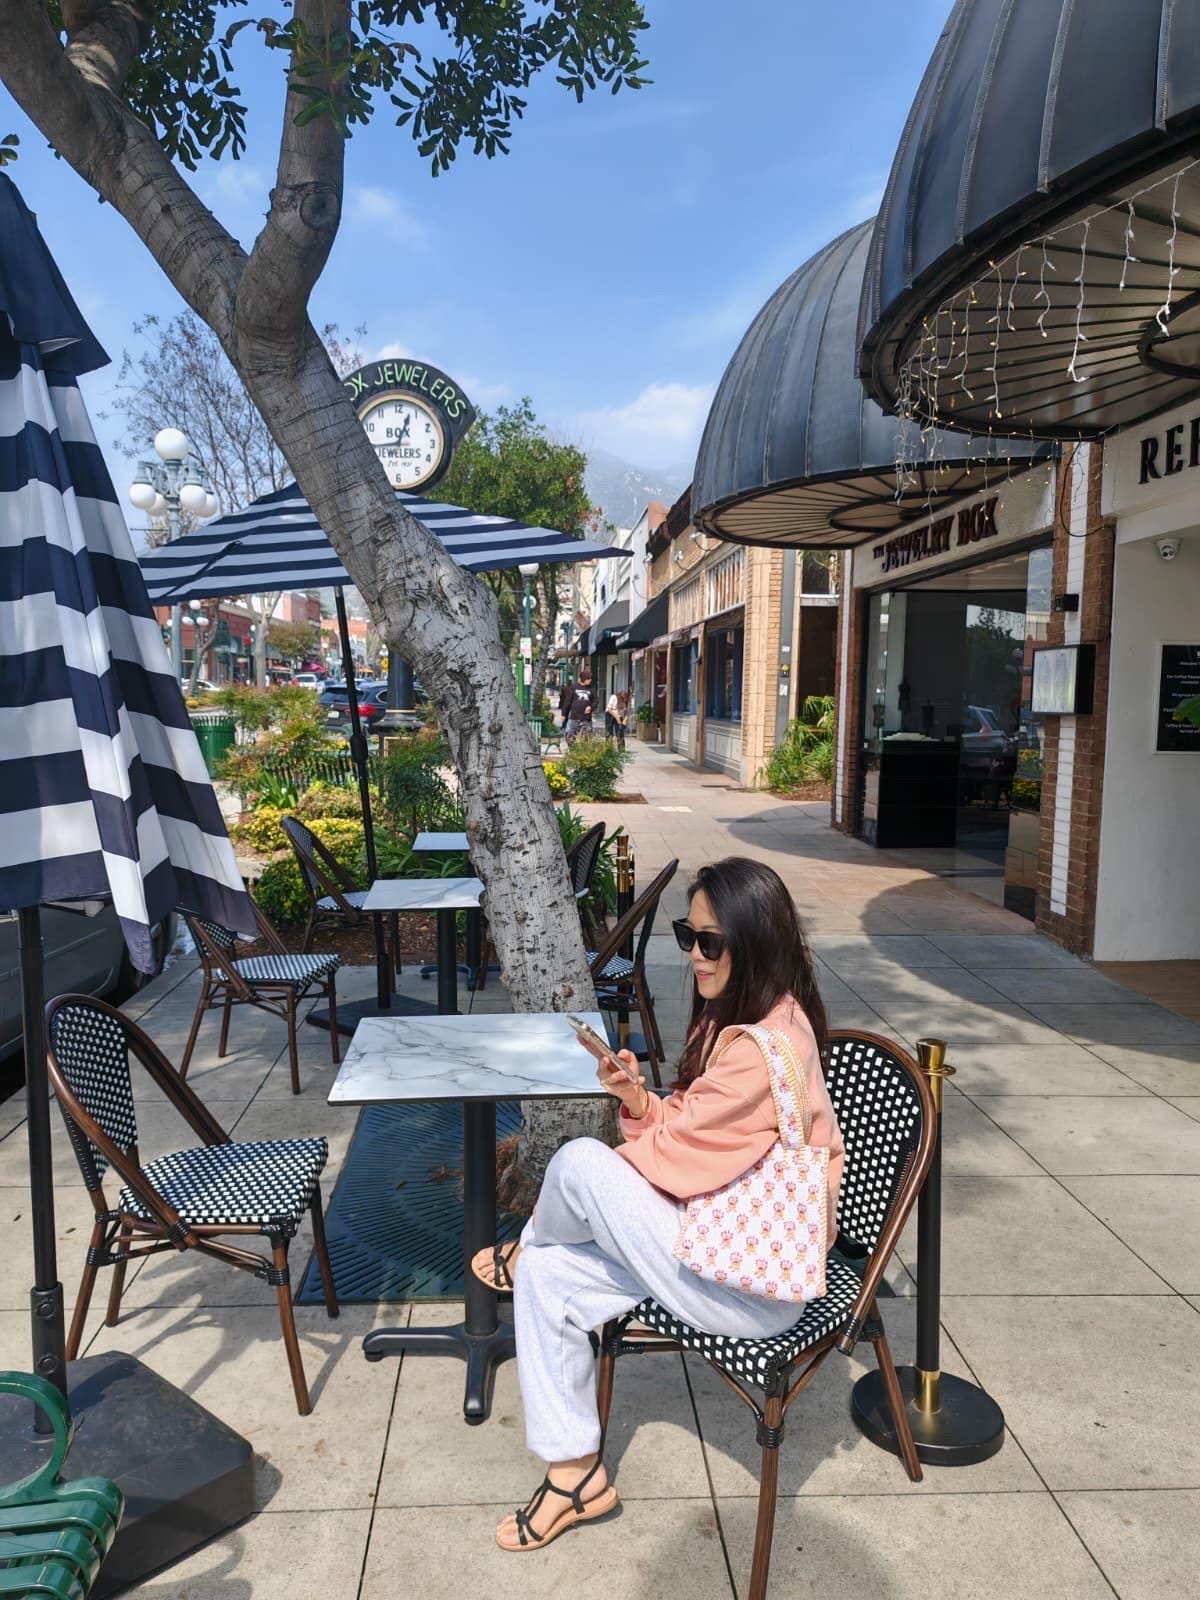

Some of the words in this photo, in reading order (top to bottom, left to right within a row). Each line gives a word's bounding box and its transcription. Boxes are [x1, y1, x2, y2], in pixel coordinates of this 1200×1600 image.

[344, 372, 369, 401] OX
[374, 362, 466, 418] JEWELERS
[378, 409, 384, 419] 11
[394, 404, 404, 414] 12
[386, 427, 411, 438] BOX
[425, 423, 431, 433] 2
[430, 439, 436, 449] 3
[378, 447, 421, 458] JEWELERS
[425, 454, 432, 463] 4
[414, 466, 421, 476] 5
[395, 474, 402, 484] 6
[882, 515, 955, 573] JEWELRY
[957, 496, 999, 547] BOX
